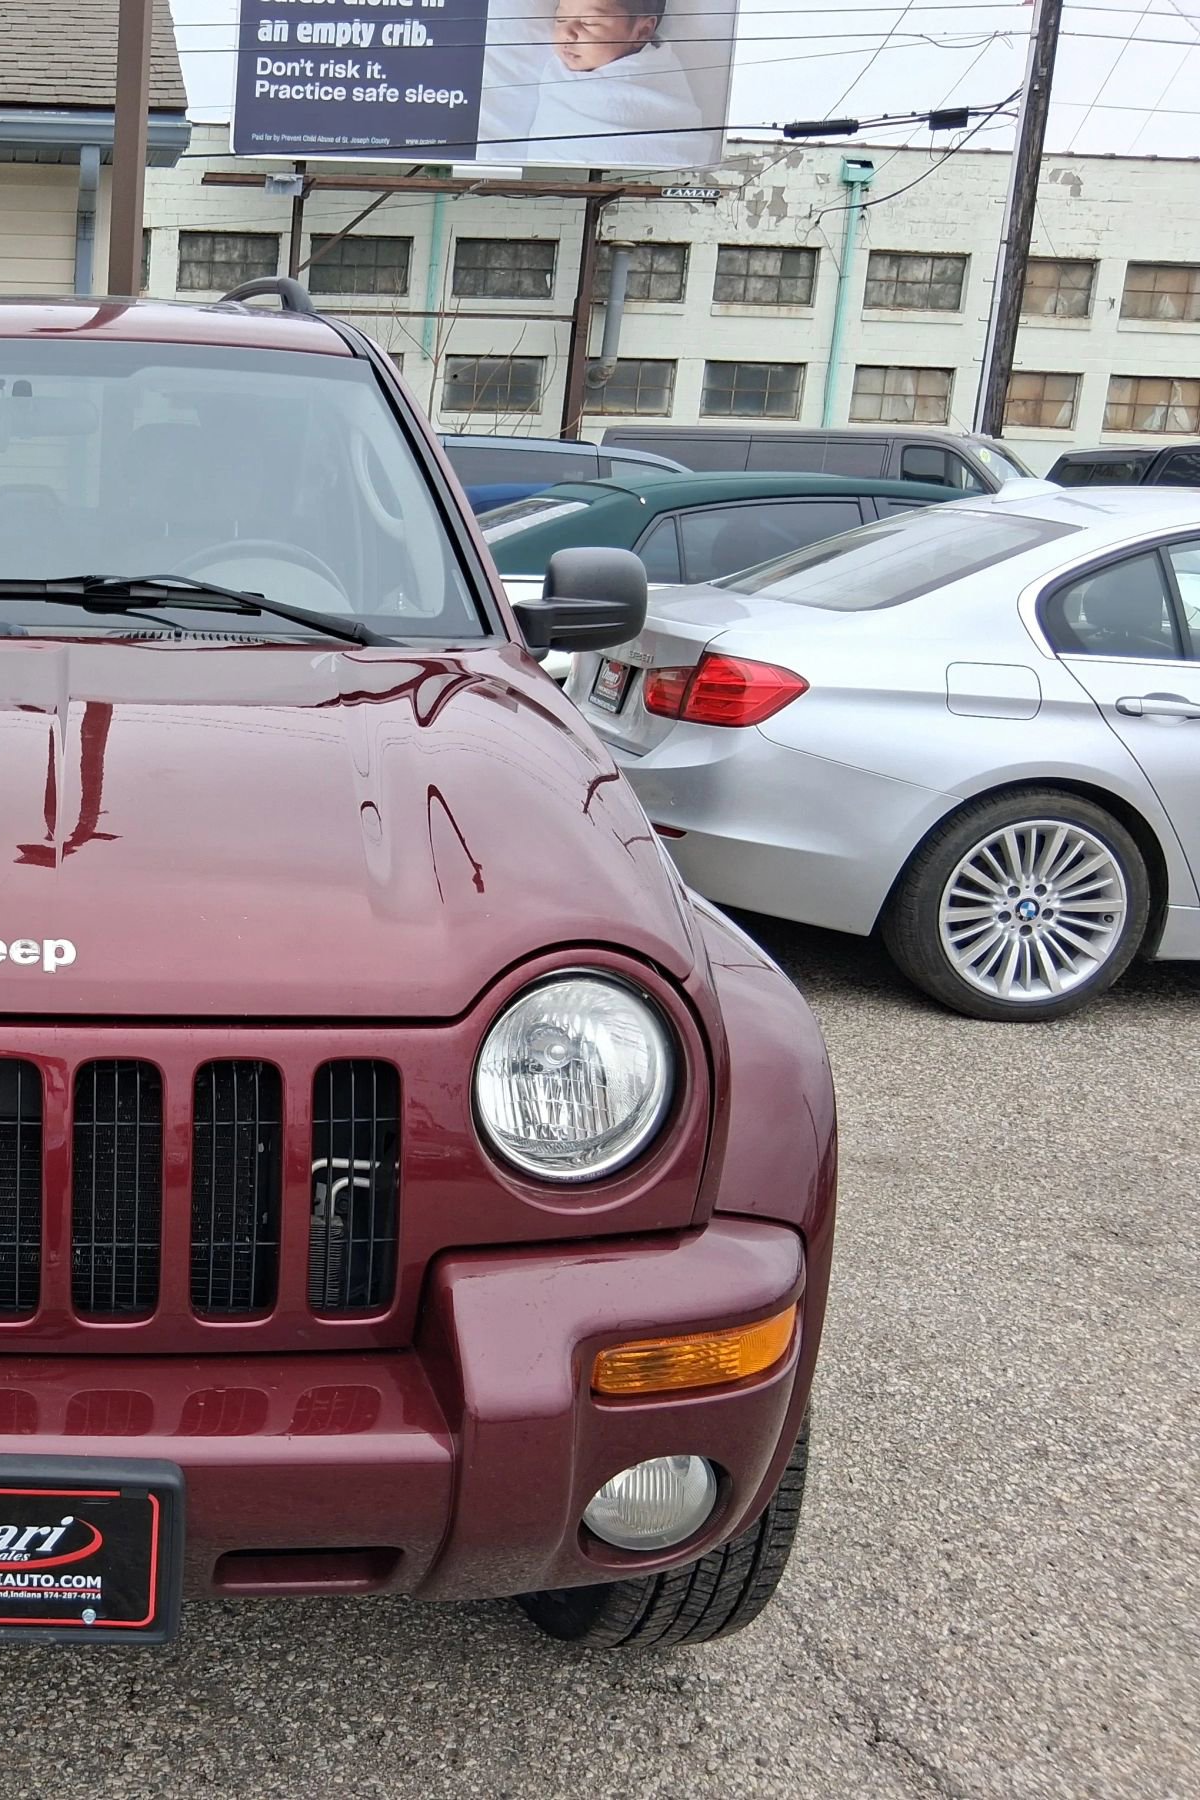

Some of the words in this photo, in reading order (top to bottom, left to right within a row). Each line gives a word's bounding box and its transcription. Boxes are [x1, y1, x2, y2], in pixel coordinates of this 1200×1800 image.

[257, 19, 289, 42] an
[296, 18, 376, 48] empty
[381, 18, 434, 47] crib.
[256, 57, 314, 77] Don't
[319, 60, 360, 79] risk
[366, 61, 387, 79] it.
[255, 80, 347, 101] Practice
[352, 84, 400, 103] safe
[404, 84, 469, 108] sleep.
[251, 133, 264, 141] Paid
[264, 133, 273, 141] for
[273, 134, 280, 143] by
[370, 137, 391, 145] County
[666, 188, 715, 198] LAMAR
[43, 1591, 102, 1600] 574-287-4714
